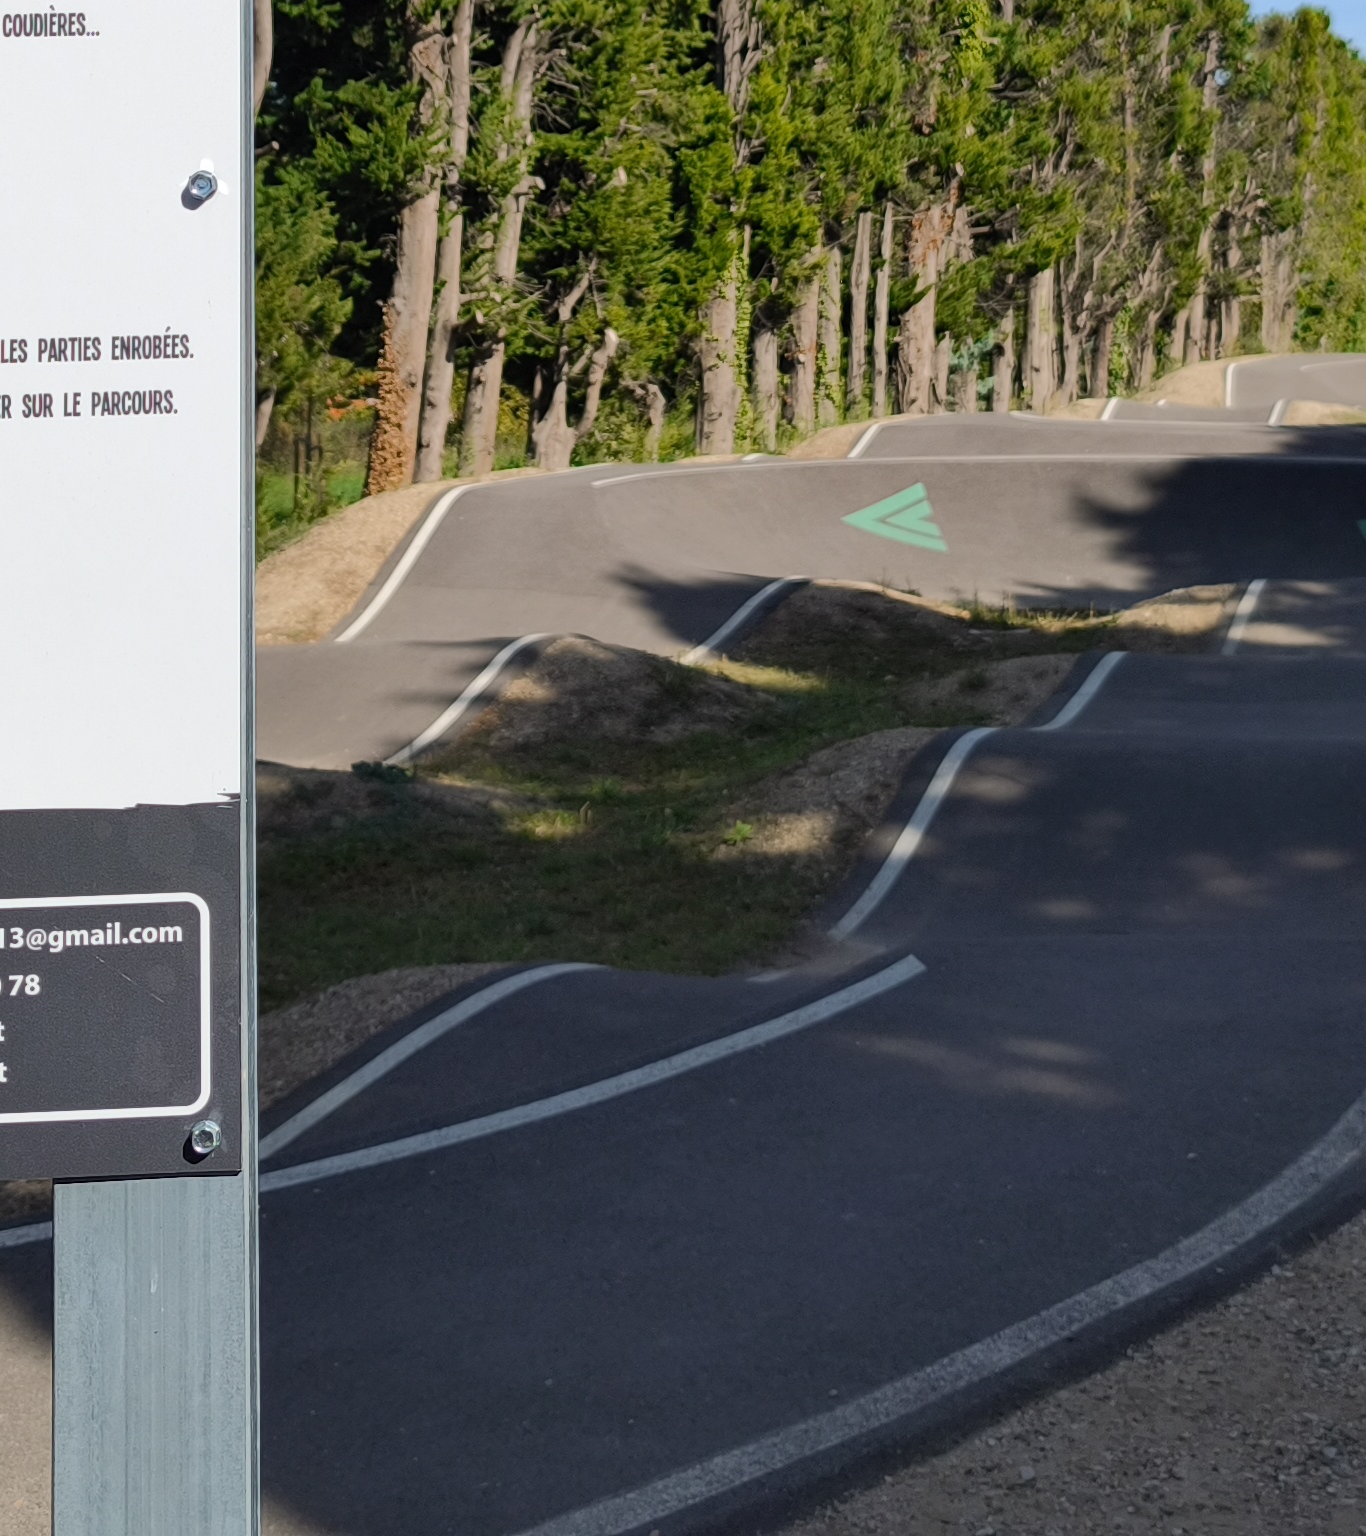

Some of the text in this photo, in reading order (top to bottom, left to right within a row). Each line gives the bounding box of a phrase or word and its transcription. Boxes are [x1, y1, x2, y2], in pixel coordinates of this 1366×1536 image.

[21, 393, 54, 419] SUR
[63, 392, 82, 417] LE
[91, 389, 178, 417] PARCOURS.
[8, 973, 41, 997] 78
